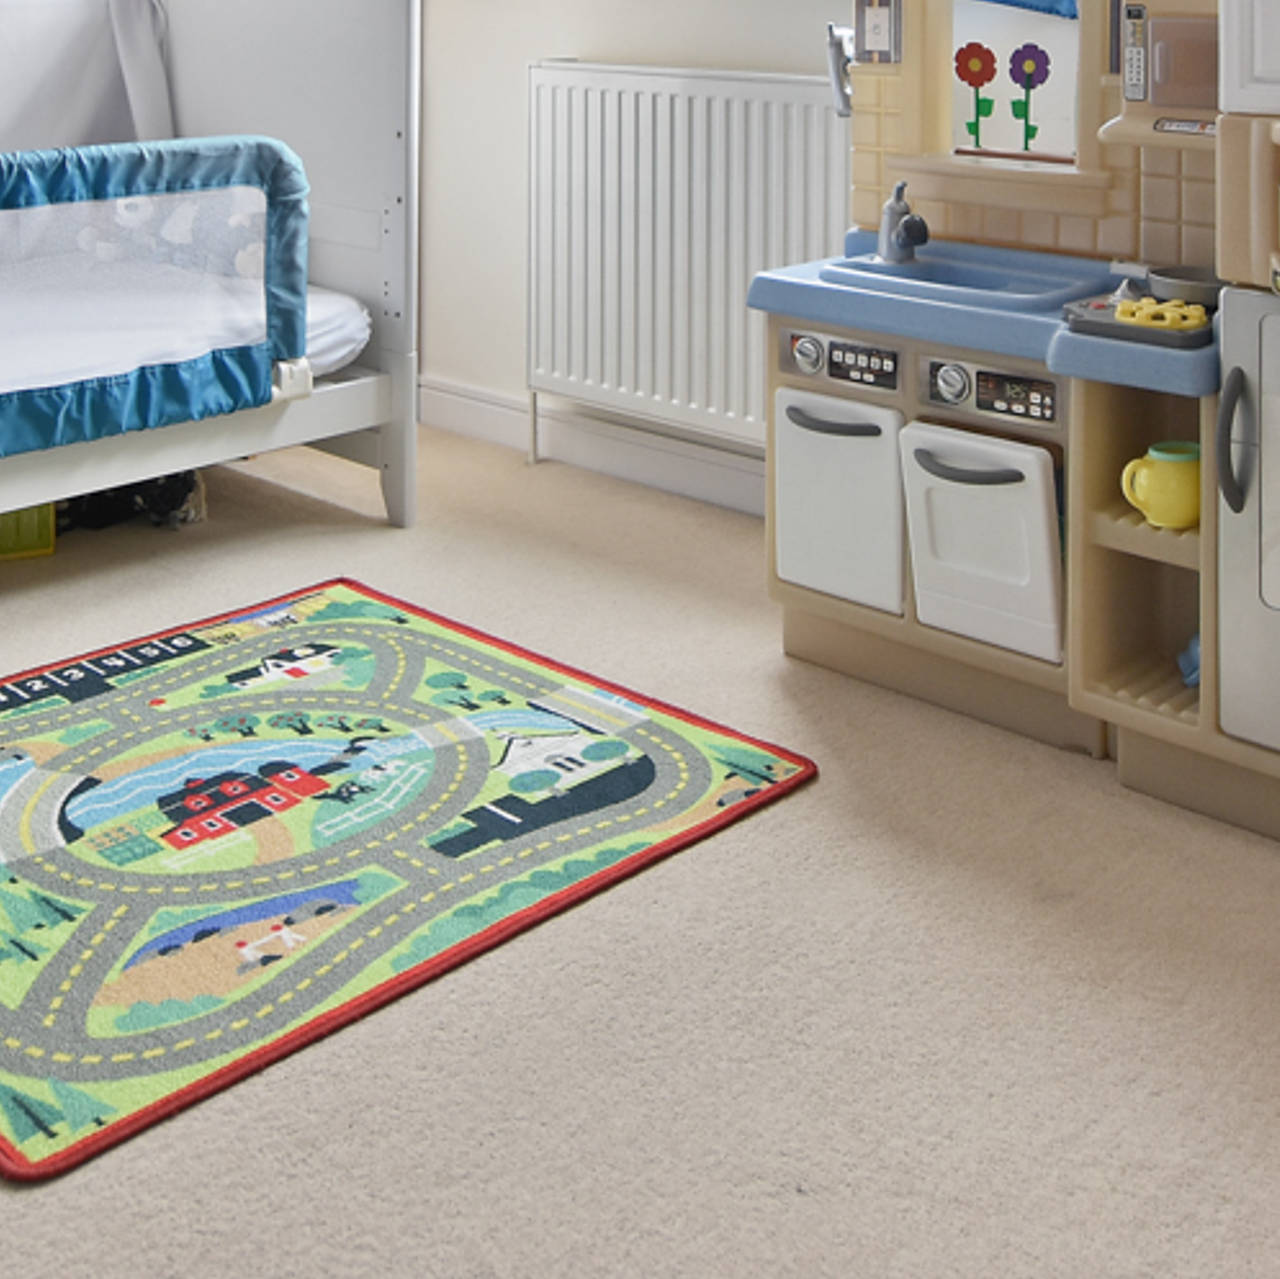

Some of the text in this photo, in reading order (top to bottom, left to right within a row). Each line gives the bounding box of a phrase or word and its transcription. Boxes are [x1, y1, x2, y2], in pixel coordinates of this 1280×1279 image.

[26, 679, 49, 692] 2
[62, 669, 85, 681] 3
[101, 656, 126, 667] 4
[138, 645, 161, 658] 5
[171, 636, 194, 648] 6
